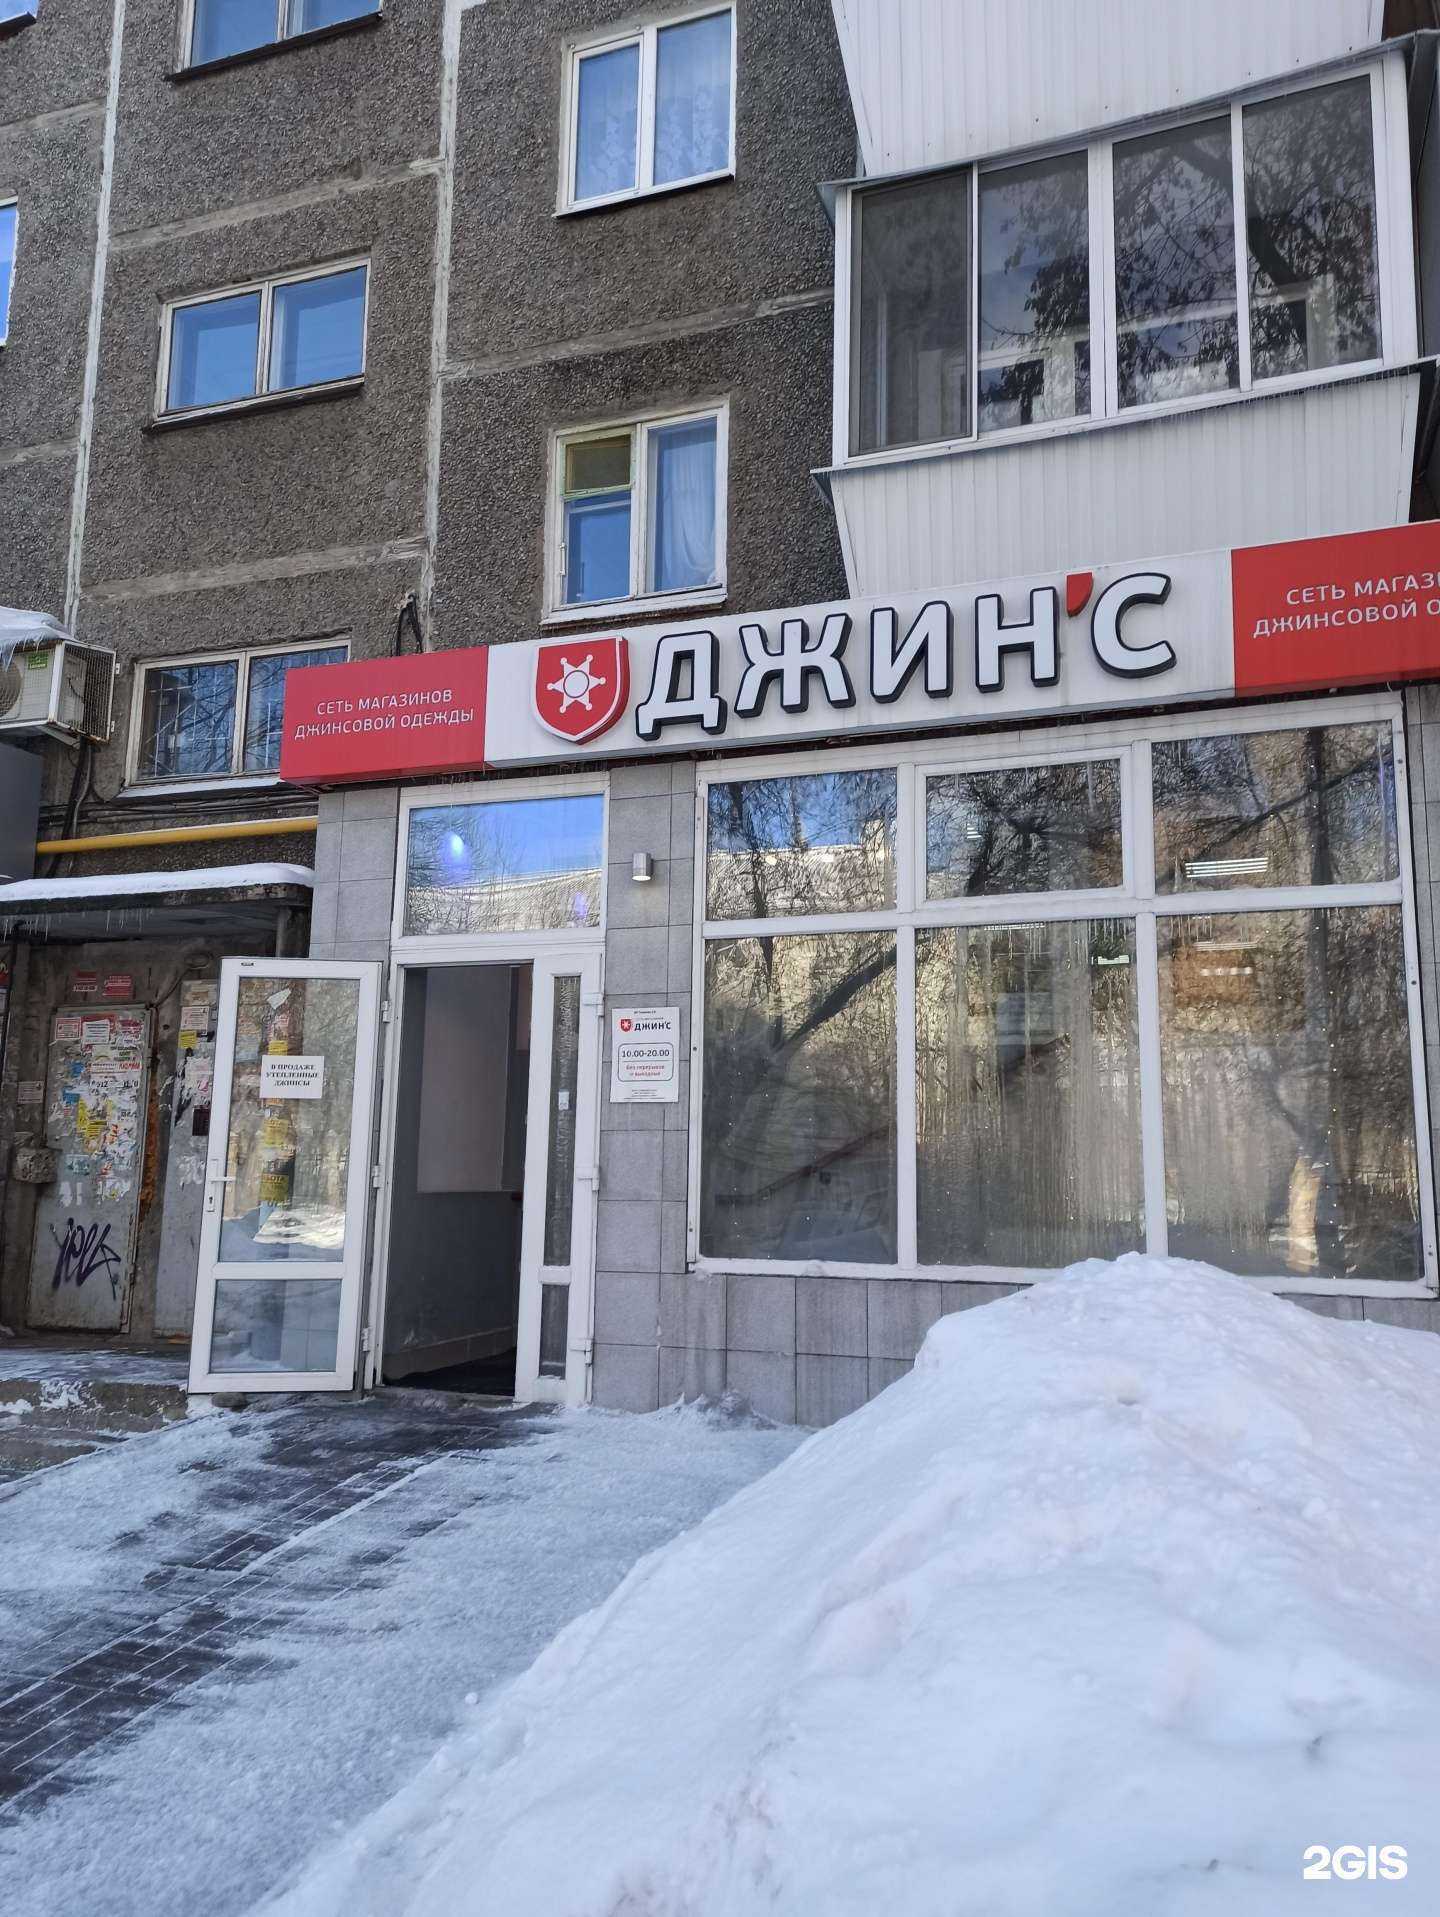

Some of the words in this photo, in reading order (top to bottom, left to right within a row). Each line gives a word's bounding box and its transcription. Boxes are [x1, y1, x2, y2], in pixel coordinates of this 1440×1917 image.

[1286, 584, 1346, 606] СЕТЬ
[1252, 597, 1418, 639] ДЖИНСОВОЙ
[636, 572, 1177, 741] ДЖИН'С
[317, 700, 354, 716] СЕТЬ
[358, 689, 453, 712] МАГАЗИНОВ
[294, 713, 396, 741] ДЖИНСОВОЙ
[400, 708, 475, 730] ОДЕЖДЫ
[621, 1049, 670, 1058] 10.00-20.00
[278, 1063, 315, 1071] ПРОДАЖЕ
[274, 1079, 311, 1087] ДЖИНСЫ
